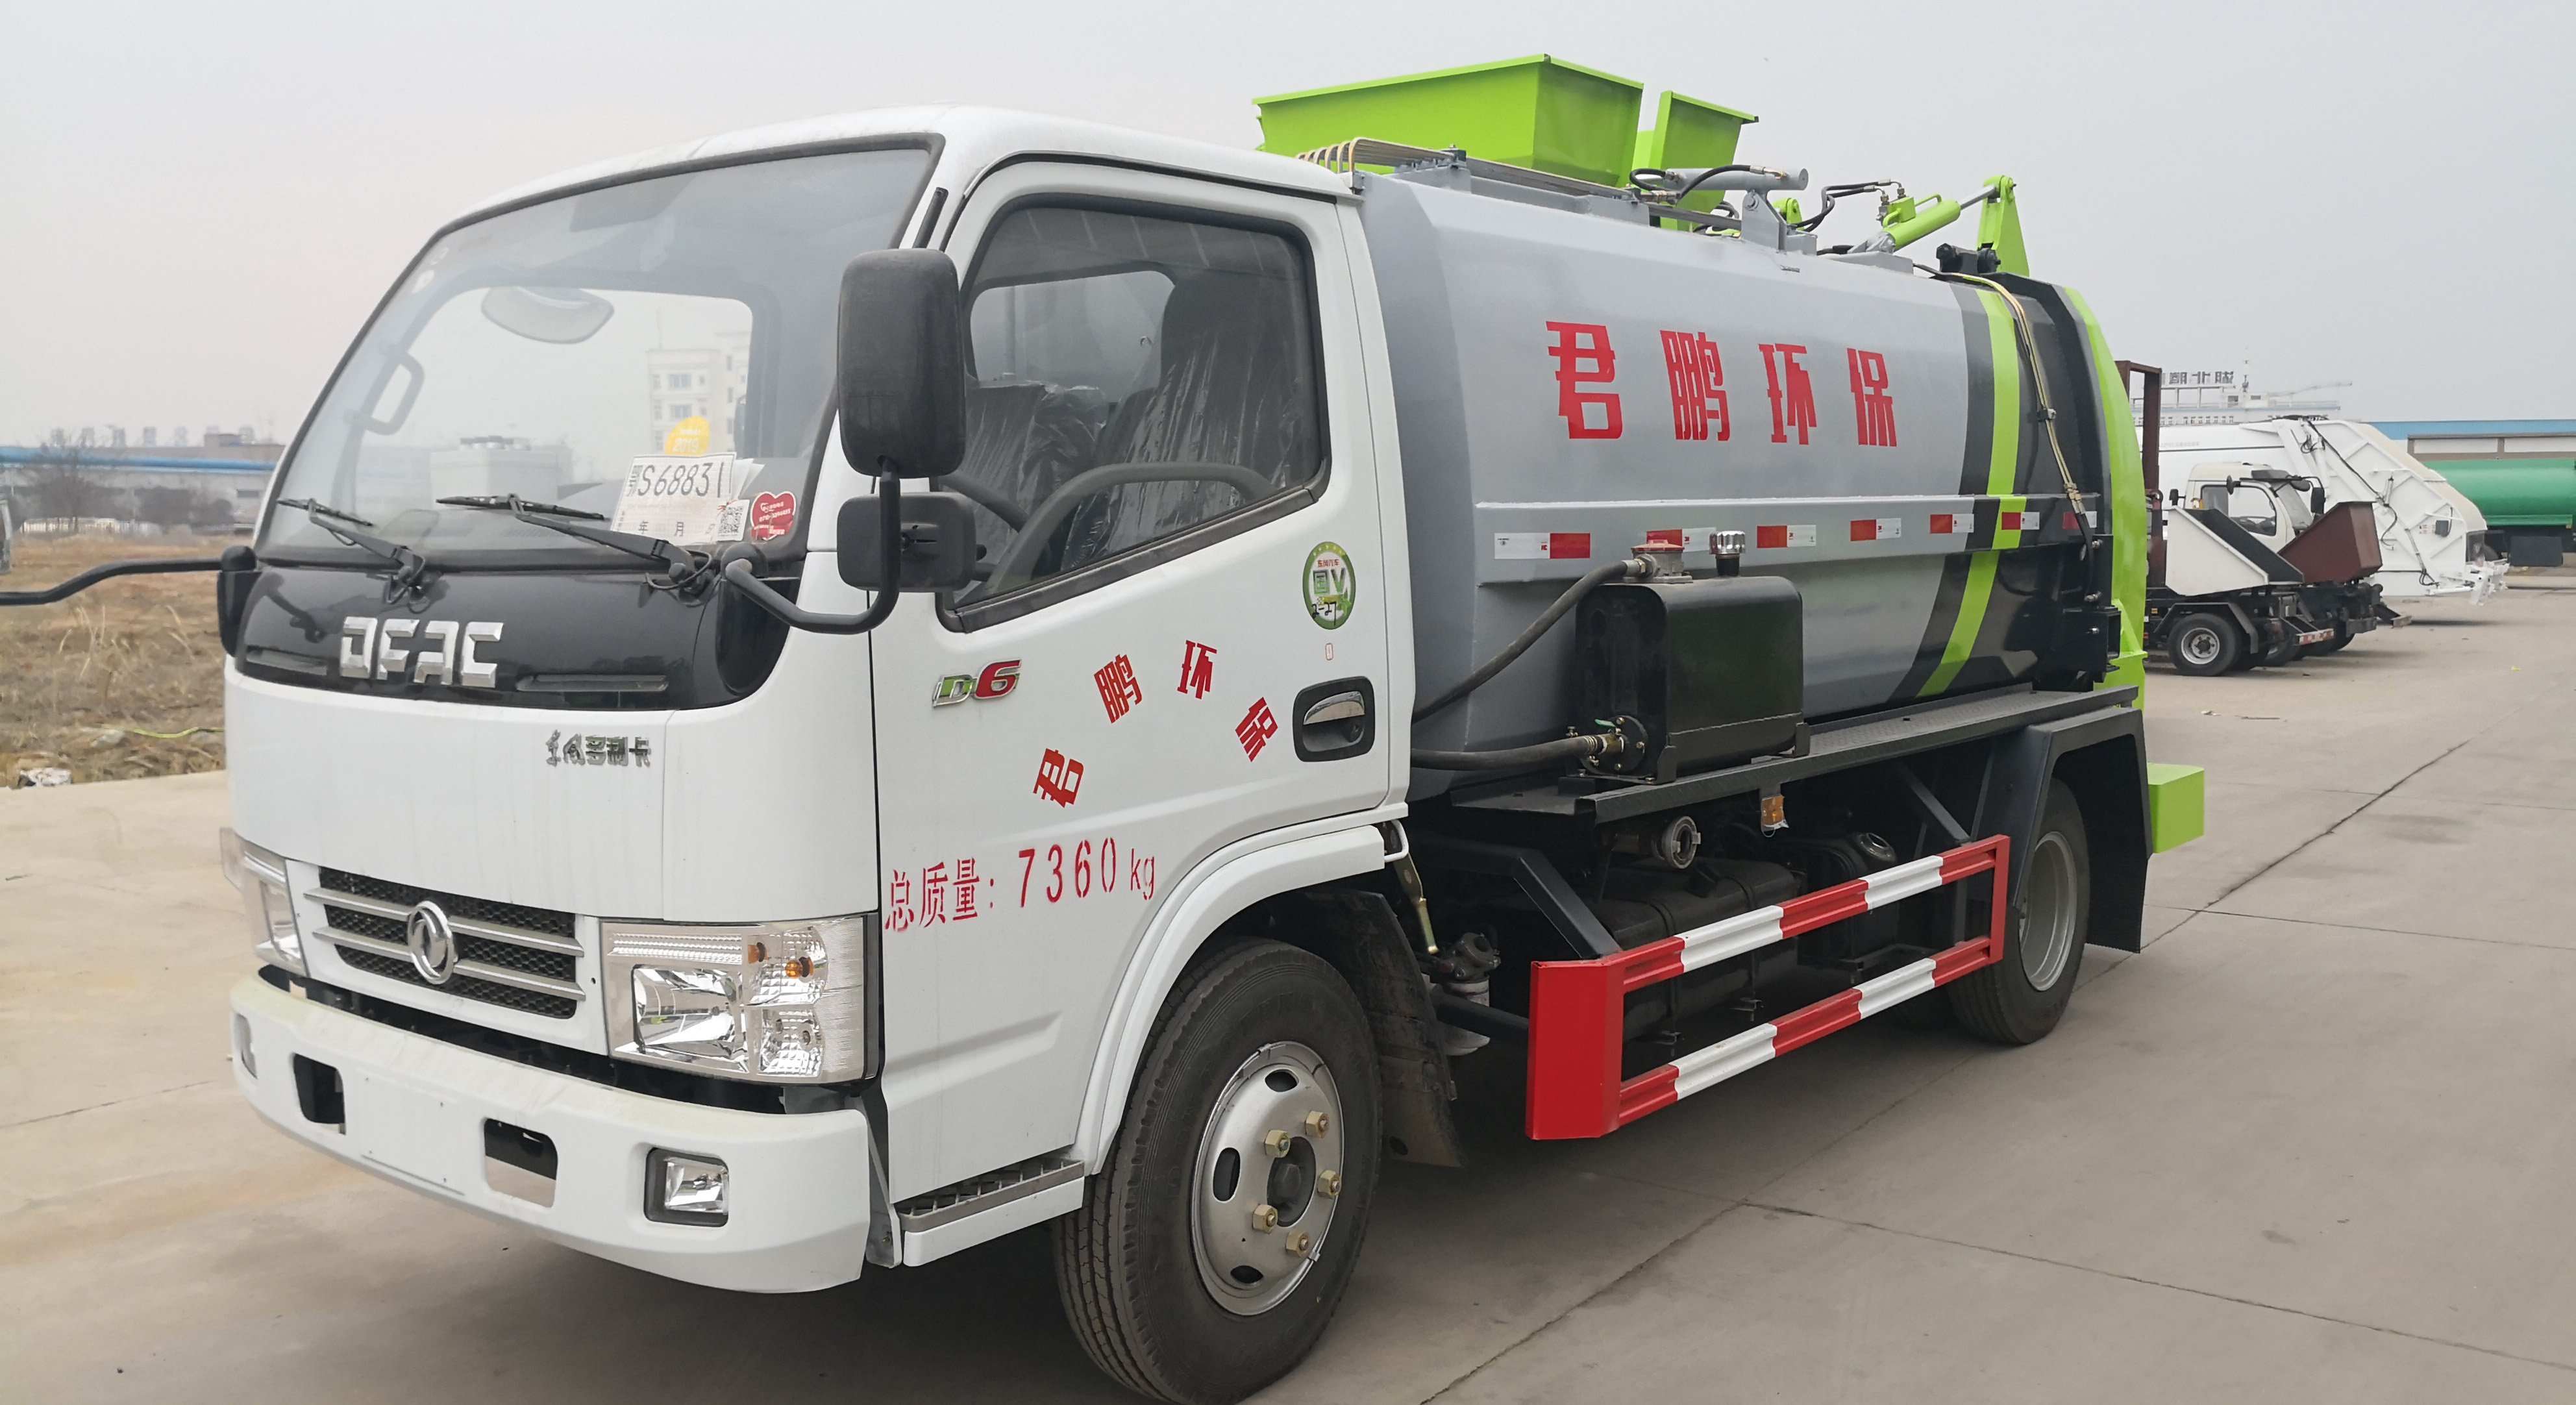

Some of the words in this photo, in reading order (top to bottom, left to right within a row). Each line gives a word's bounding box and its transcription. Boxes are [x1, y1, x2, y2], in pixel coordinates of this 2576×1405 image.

[1546, 321, 1897, 447] 君鹏环保
[638, 520, 649, 535] 年
[674, 521, 684, 537] 月
[340, 615, 504, 688] DFAC
[932, 658, 1022, 708] D6
[1032, 640, 1279, 808] 君鹏环保
[1018, 836, 1117, 908] 7360
[1130, 848, 1156, 900] kg
